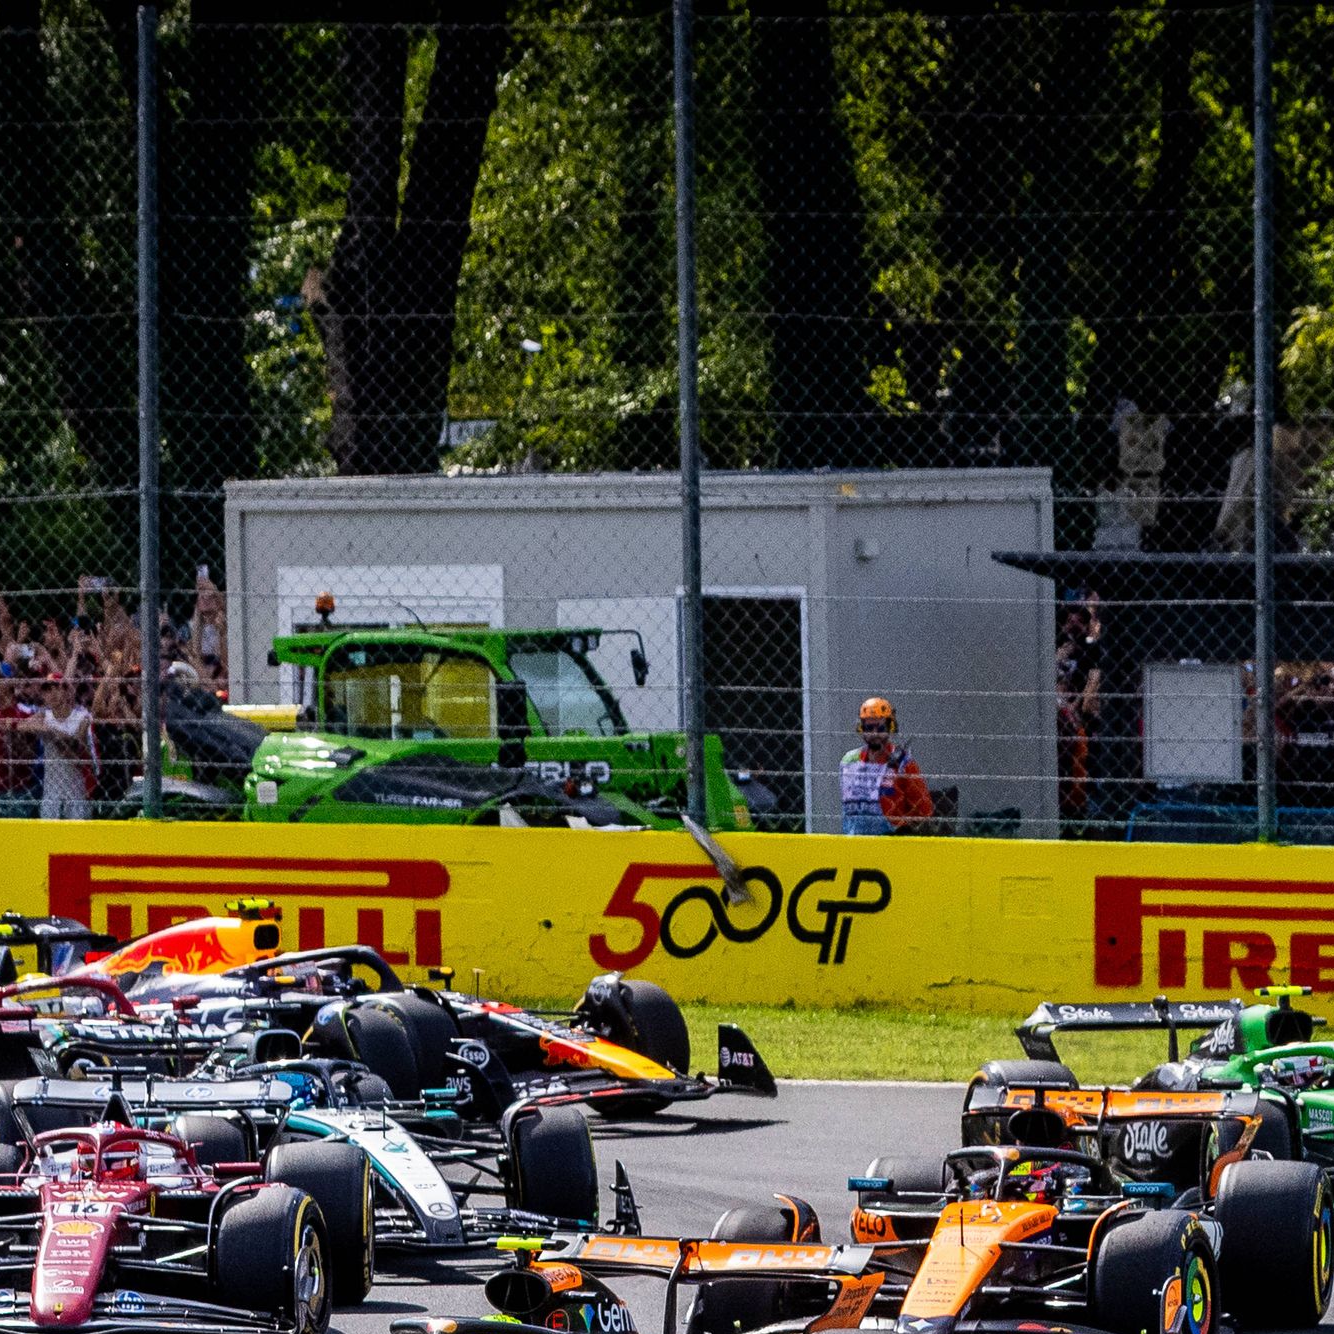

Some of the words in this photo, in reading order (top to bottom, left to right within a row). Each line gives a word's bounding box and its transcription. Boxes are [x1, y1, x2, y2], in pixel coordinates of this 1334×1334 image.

[48, 854, 450, 966] PILLI
[589, 862, 892, 972] 500GP
[1059, 1006, 1114, 1020] Stake
[1179, 1005, 1234, 1020] Stake
[732, 1051, 755, 1067] AT&T
[445, 1076, 472, 1092] aws
[1308, 1108, 1334, 1122] MASCOT
[1124, 1120, 1173, 1159] Stake
[1129, 1184, 1160, 1194] avenga
[70, 1203, 100, 1213] 16
